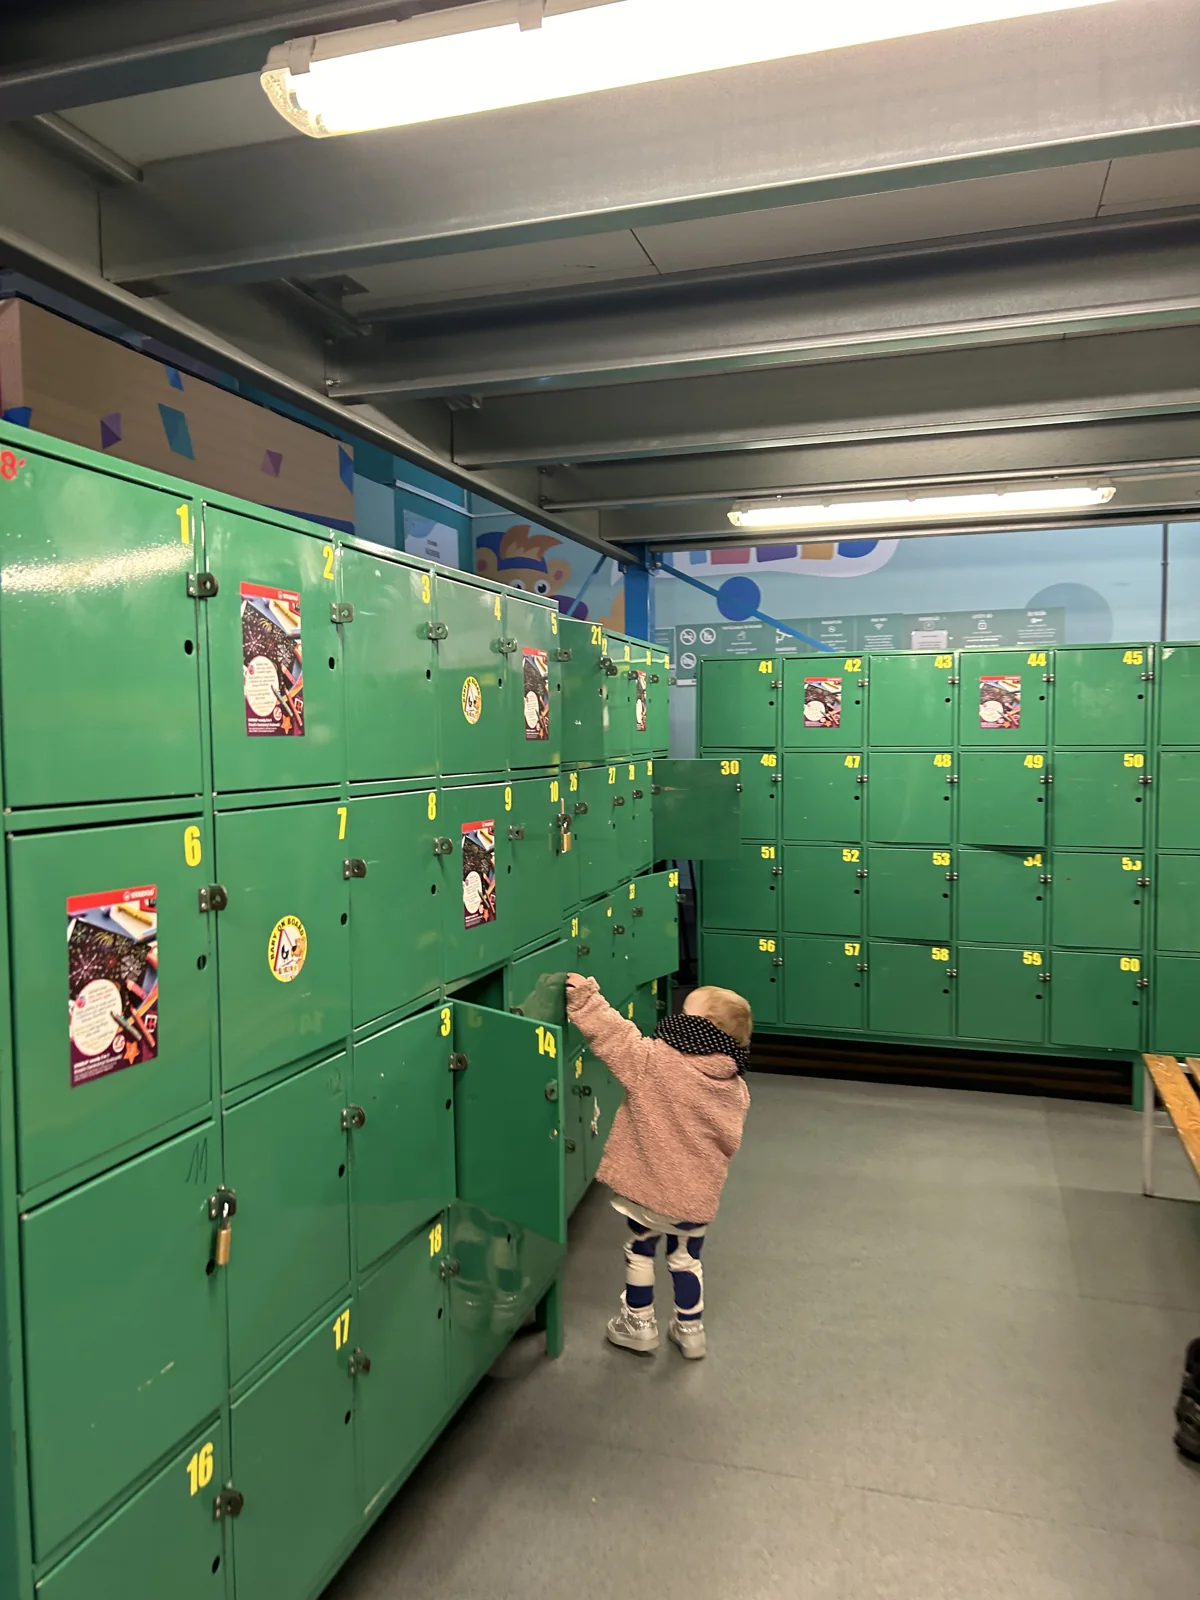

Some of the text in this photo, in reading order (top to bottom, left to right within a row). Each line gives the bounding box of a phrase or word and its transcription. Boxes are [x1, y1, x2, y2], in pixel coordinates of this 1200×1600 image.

[175, 503, 191, 546] 1
[321, 544, 335, 581] 2
[420, 574, 431, 604] 3
[493, 595, 502, 621] 4
[551, 612, 558, 635] 5
[591, 625, 602, 645] 21
[843, 657, 862, 673] 42
[934, 654, 953, 669] 43
[1027, 651, 1047, 667] 44
[1122, 650, 1144, 666] 45
[758, 660, 773, 674] 41
[720, 760, 740, 776] 30
[760, 753, 777, 767] 46
[844, 754, 861, 769] 47
[933, 753, 952, 768] 48
[1023, 754, 1044, 769] 49
[1123, 753, 1145, 768] 50
[504, 786, 512, 812] 9
[549, 780, 559, 803] 10
[427, 792, 437, 821] 8
[336, 806, 348, 840] 7
[184, 825, 202, 867] 6
[761, 846, 775, 859] 51
[842, 848, 860, 863] 52
[932, 851, 951, 866] 53
[277, 920, 286, 932] ON
[287, 918, 304, 936] BOARD
[759, 938, 776, 953] 56
[844, 942, 861, 956] 57
[931, 947, 950, 962] 58
[1022, 950, 1043, 966] 59
[1119, 957, 1140, 972] 60
[440, 1007, 451, 1037] 3
[535, 1026, 557, 1059] 14
[428, 1223, 442, 1257] 18
[332, 1309, 350, 1351] 17
[186, 1442, 214, 1496] 16
